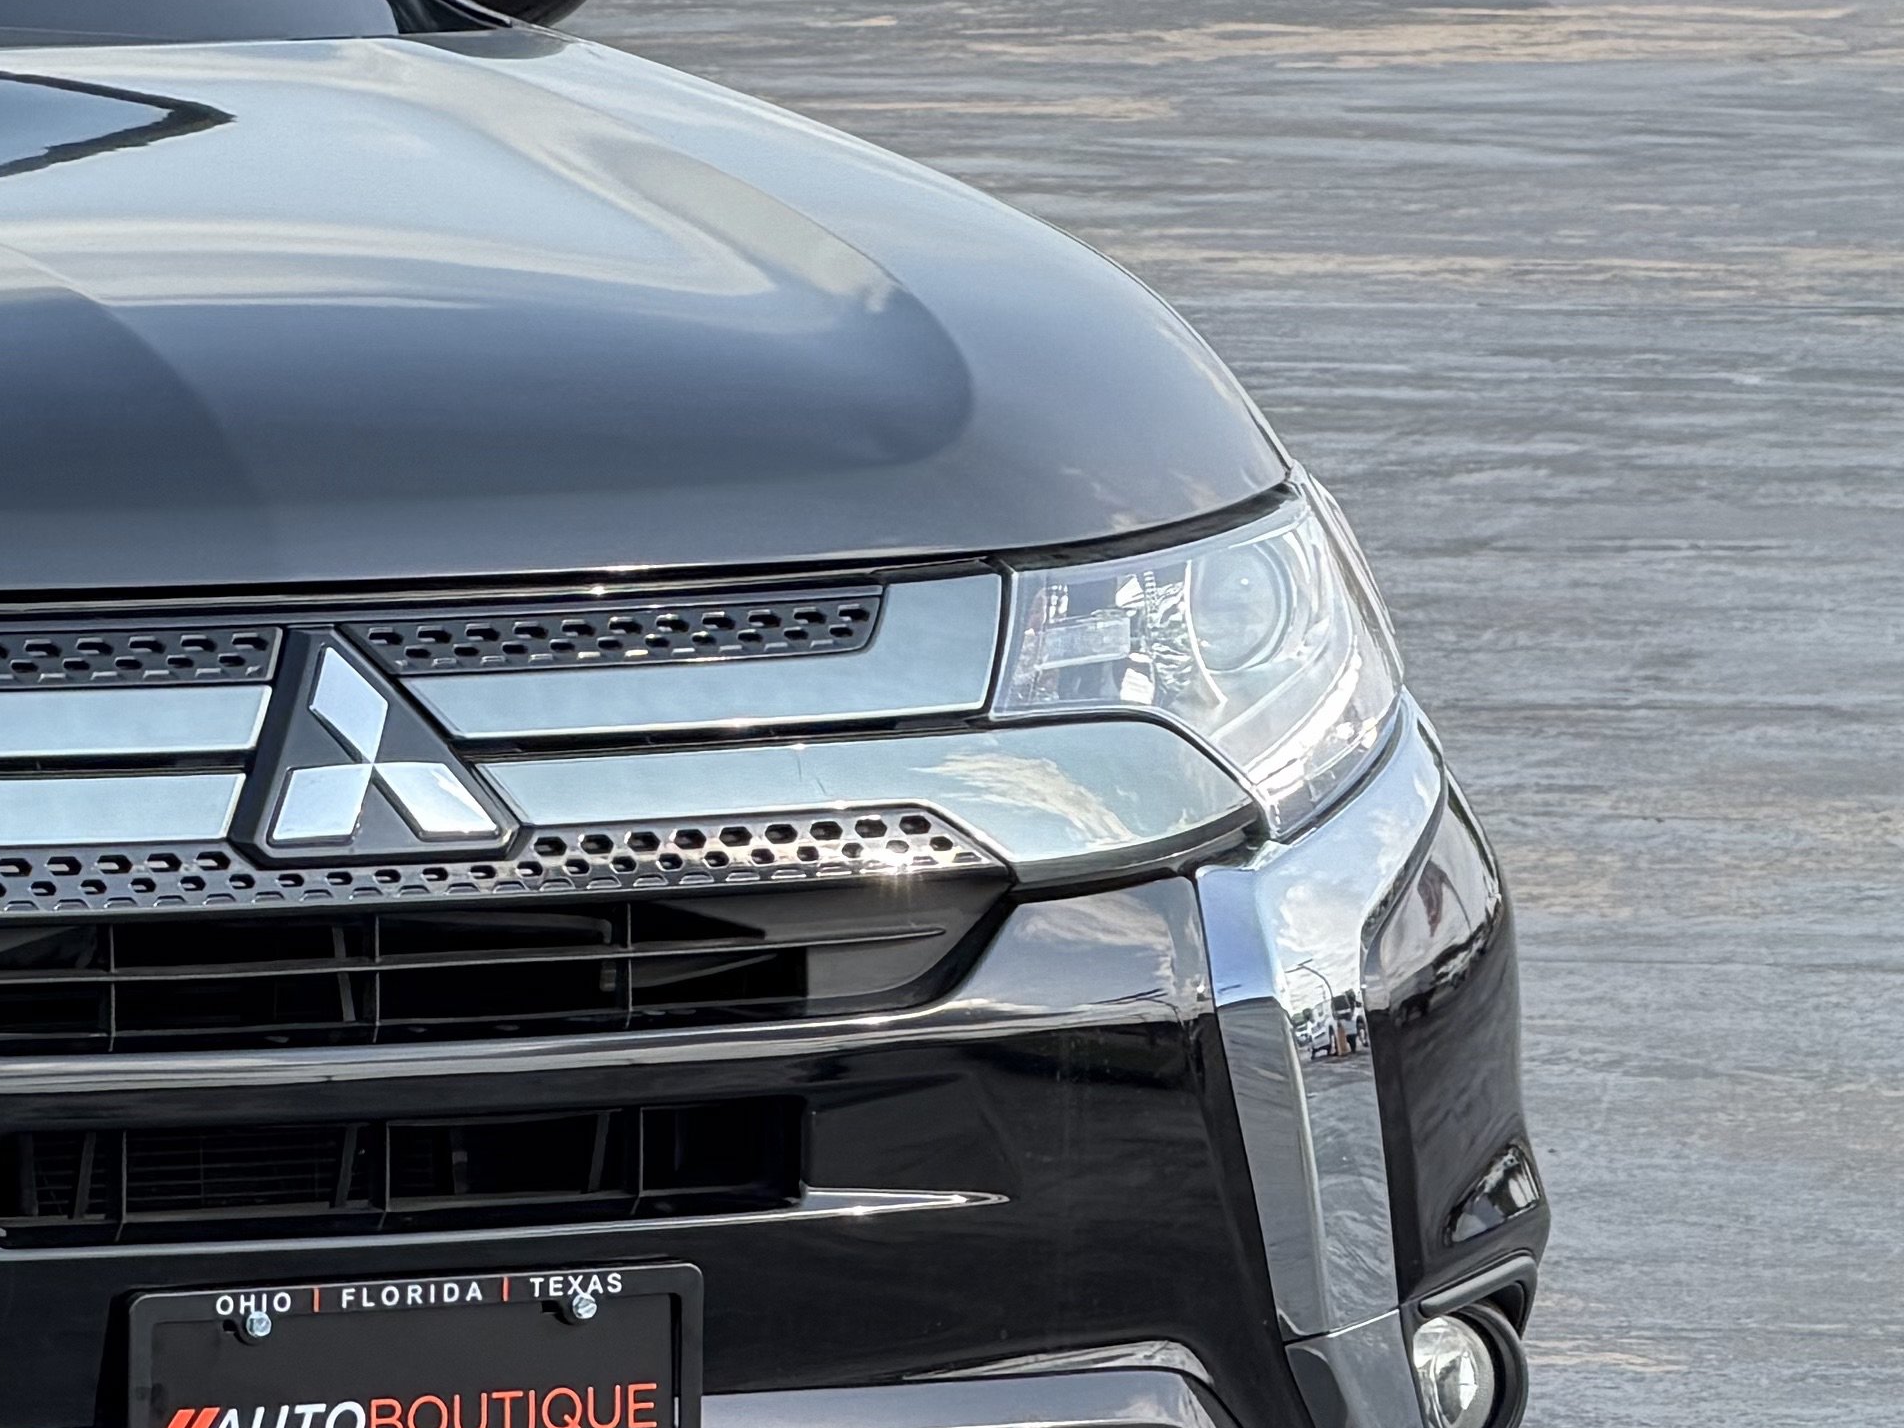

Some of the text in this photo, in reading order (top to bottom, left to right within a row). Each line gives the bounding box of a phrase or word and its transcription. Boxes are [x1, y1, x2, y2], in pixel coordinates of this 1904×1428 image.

[215, 1272, 624, 1316] OHIO FLORIDA TEXAS
